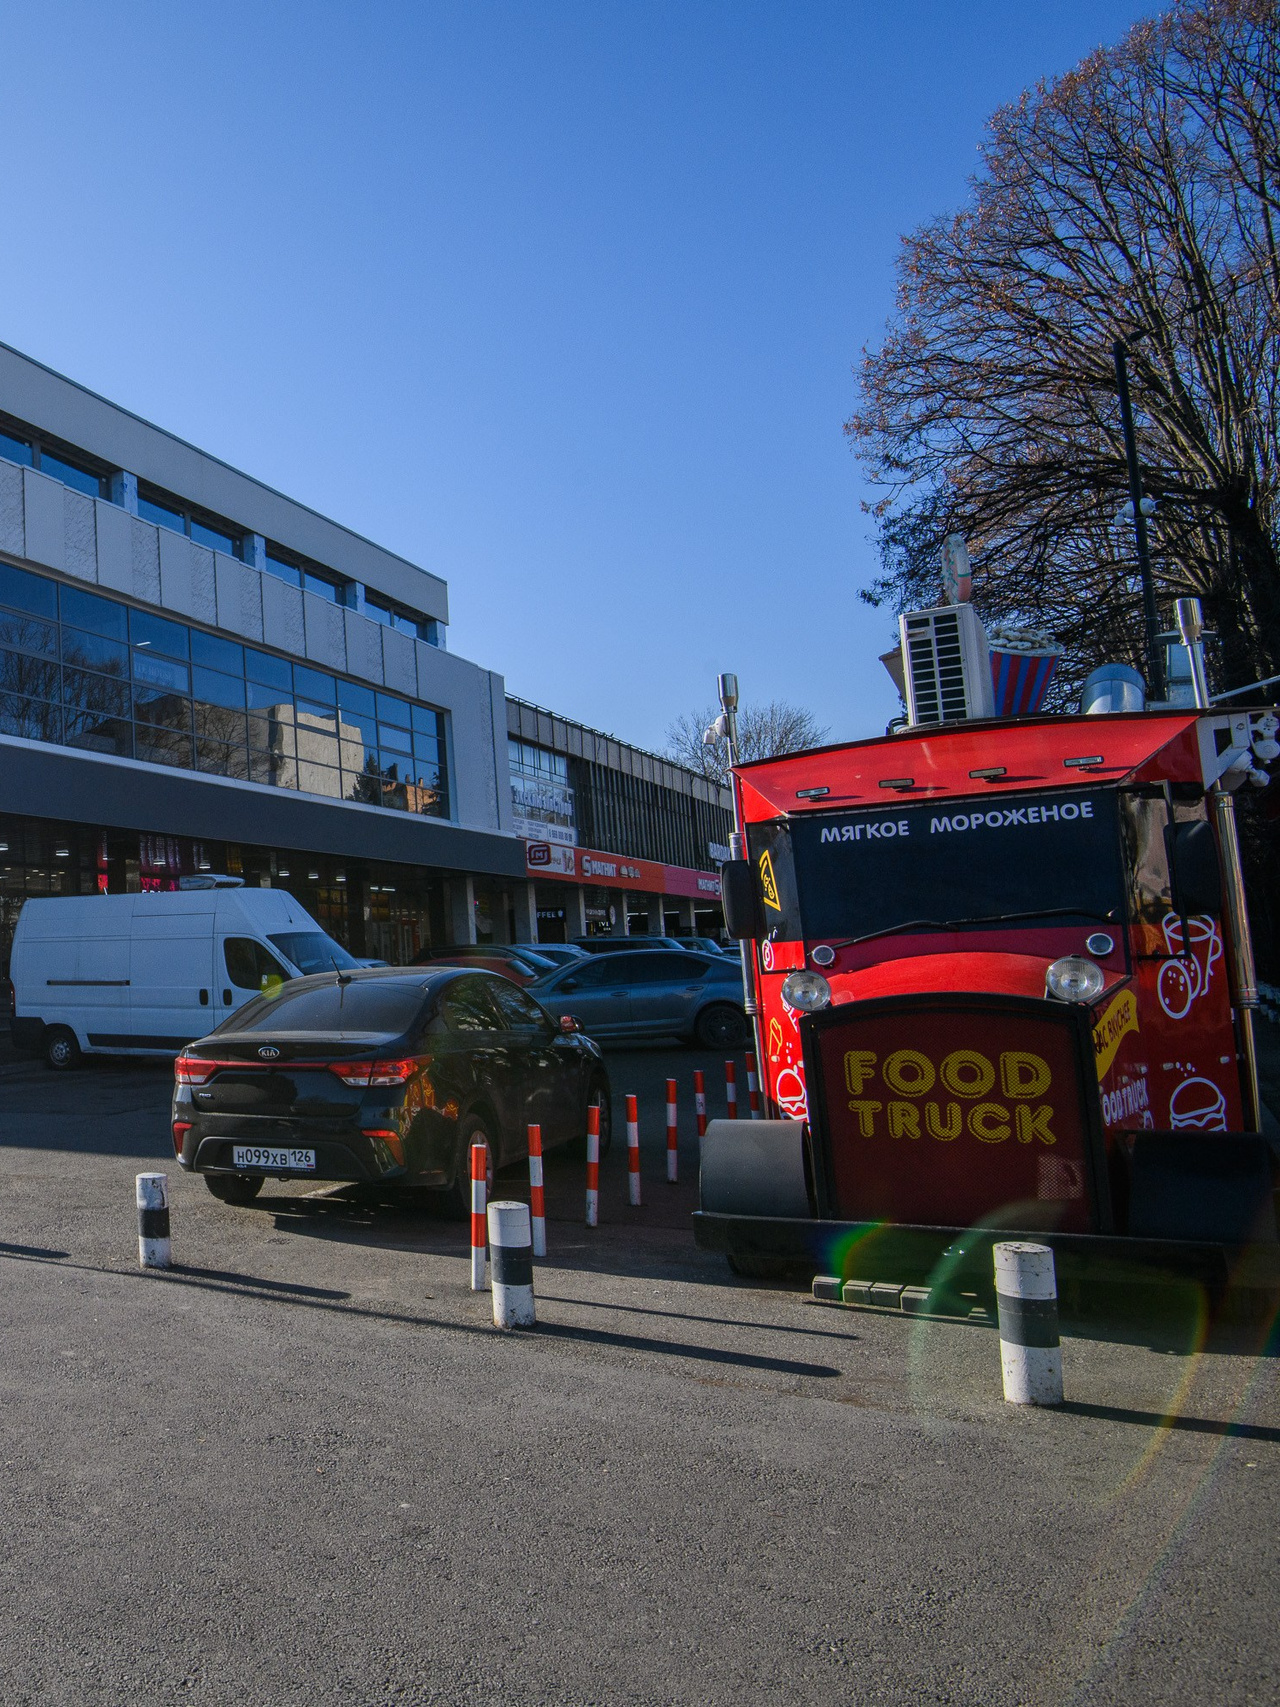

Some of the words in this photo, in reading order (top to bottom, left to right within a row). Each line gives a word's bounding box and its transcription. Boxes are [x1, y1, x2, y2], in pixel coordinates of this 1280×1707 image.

[820, 820, 910, 843] МЯГКОЕ
[930, 801, 1095, 834] МОРОЖЕНОЕ
[261, 1048, 276, 1057] KIA
[844, 1049, 1052, 1099] FOOD
[848, 1100, 1057, 1145] TRUCK
[1102, 1093, 1124, 1126] OOD
[1121, 1077, 1149, 1118] TRUCK
[291, 1150, 311, 1163] 126
